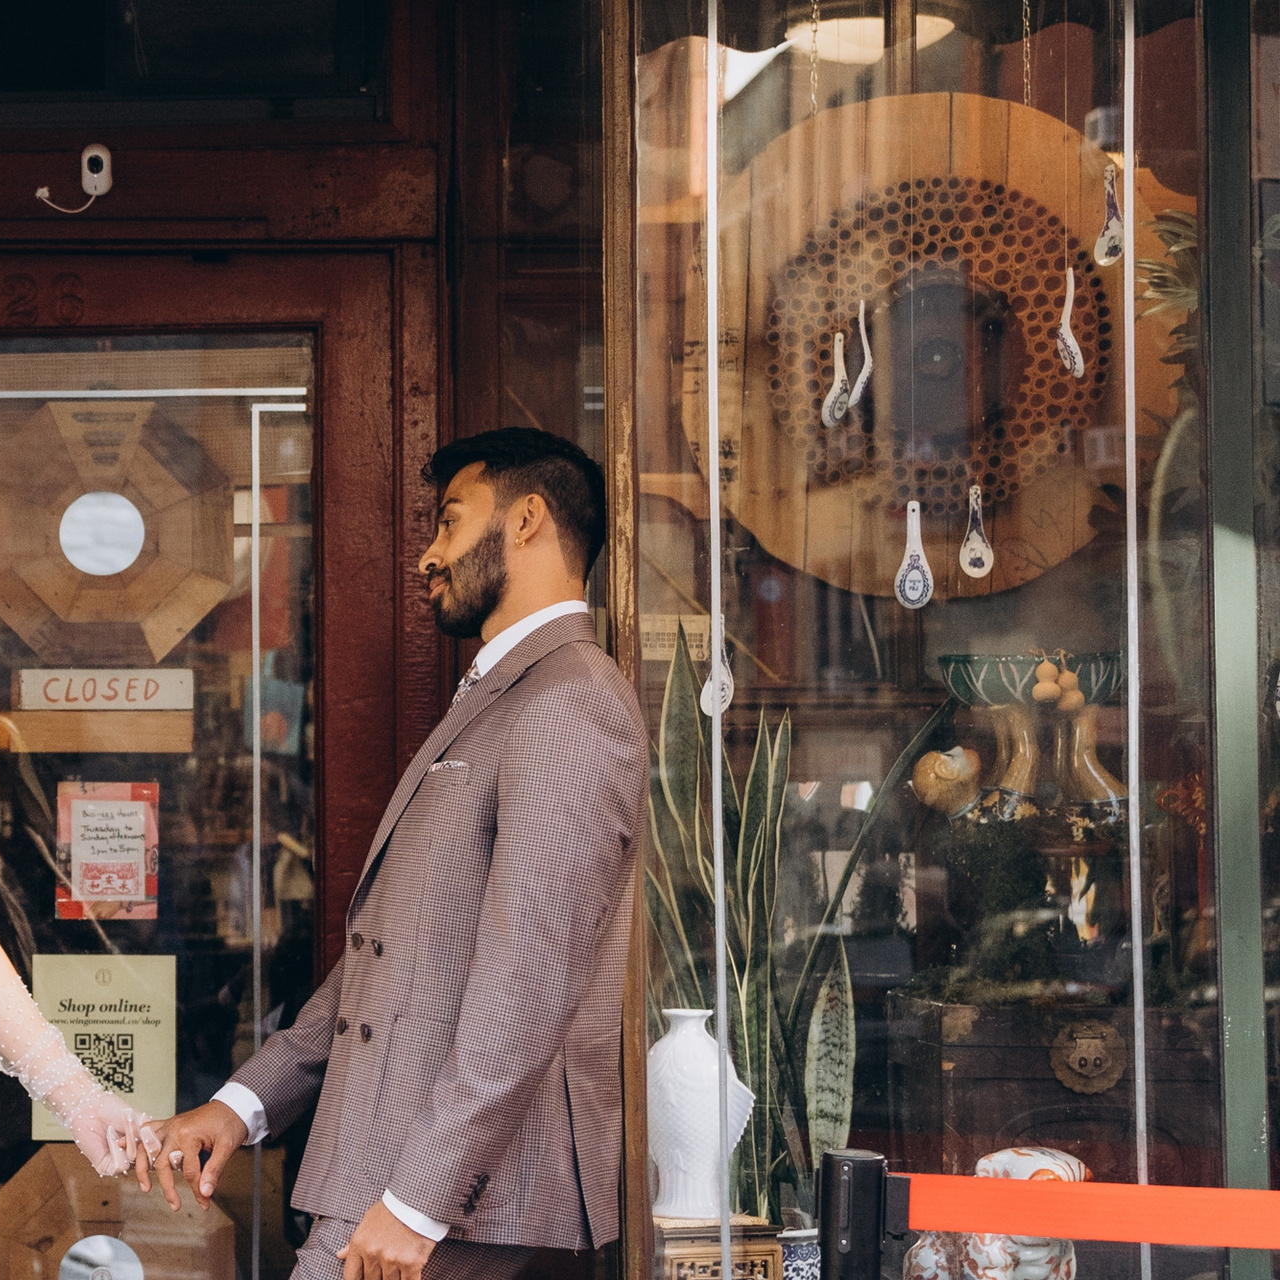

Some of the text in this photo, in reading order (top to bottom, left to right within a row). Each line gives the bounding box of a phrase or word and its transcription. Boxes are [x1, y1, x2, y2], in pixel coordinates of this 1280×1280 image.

[43, 677, 160, 704] CLOSED
[80, 832, 109, 844] Sunday
[58, 998, 151, 1017] Shop online:
